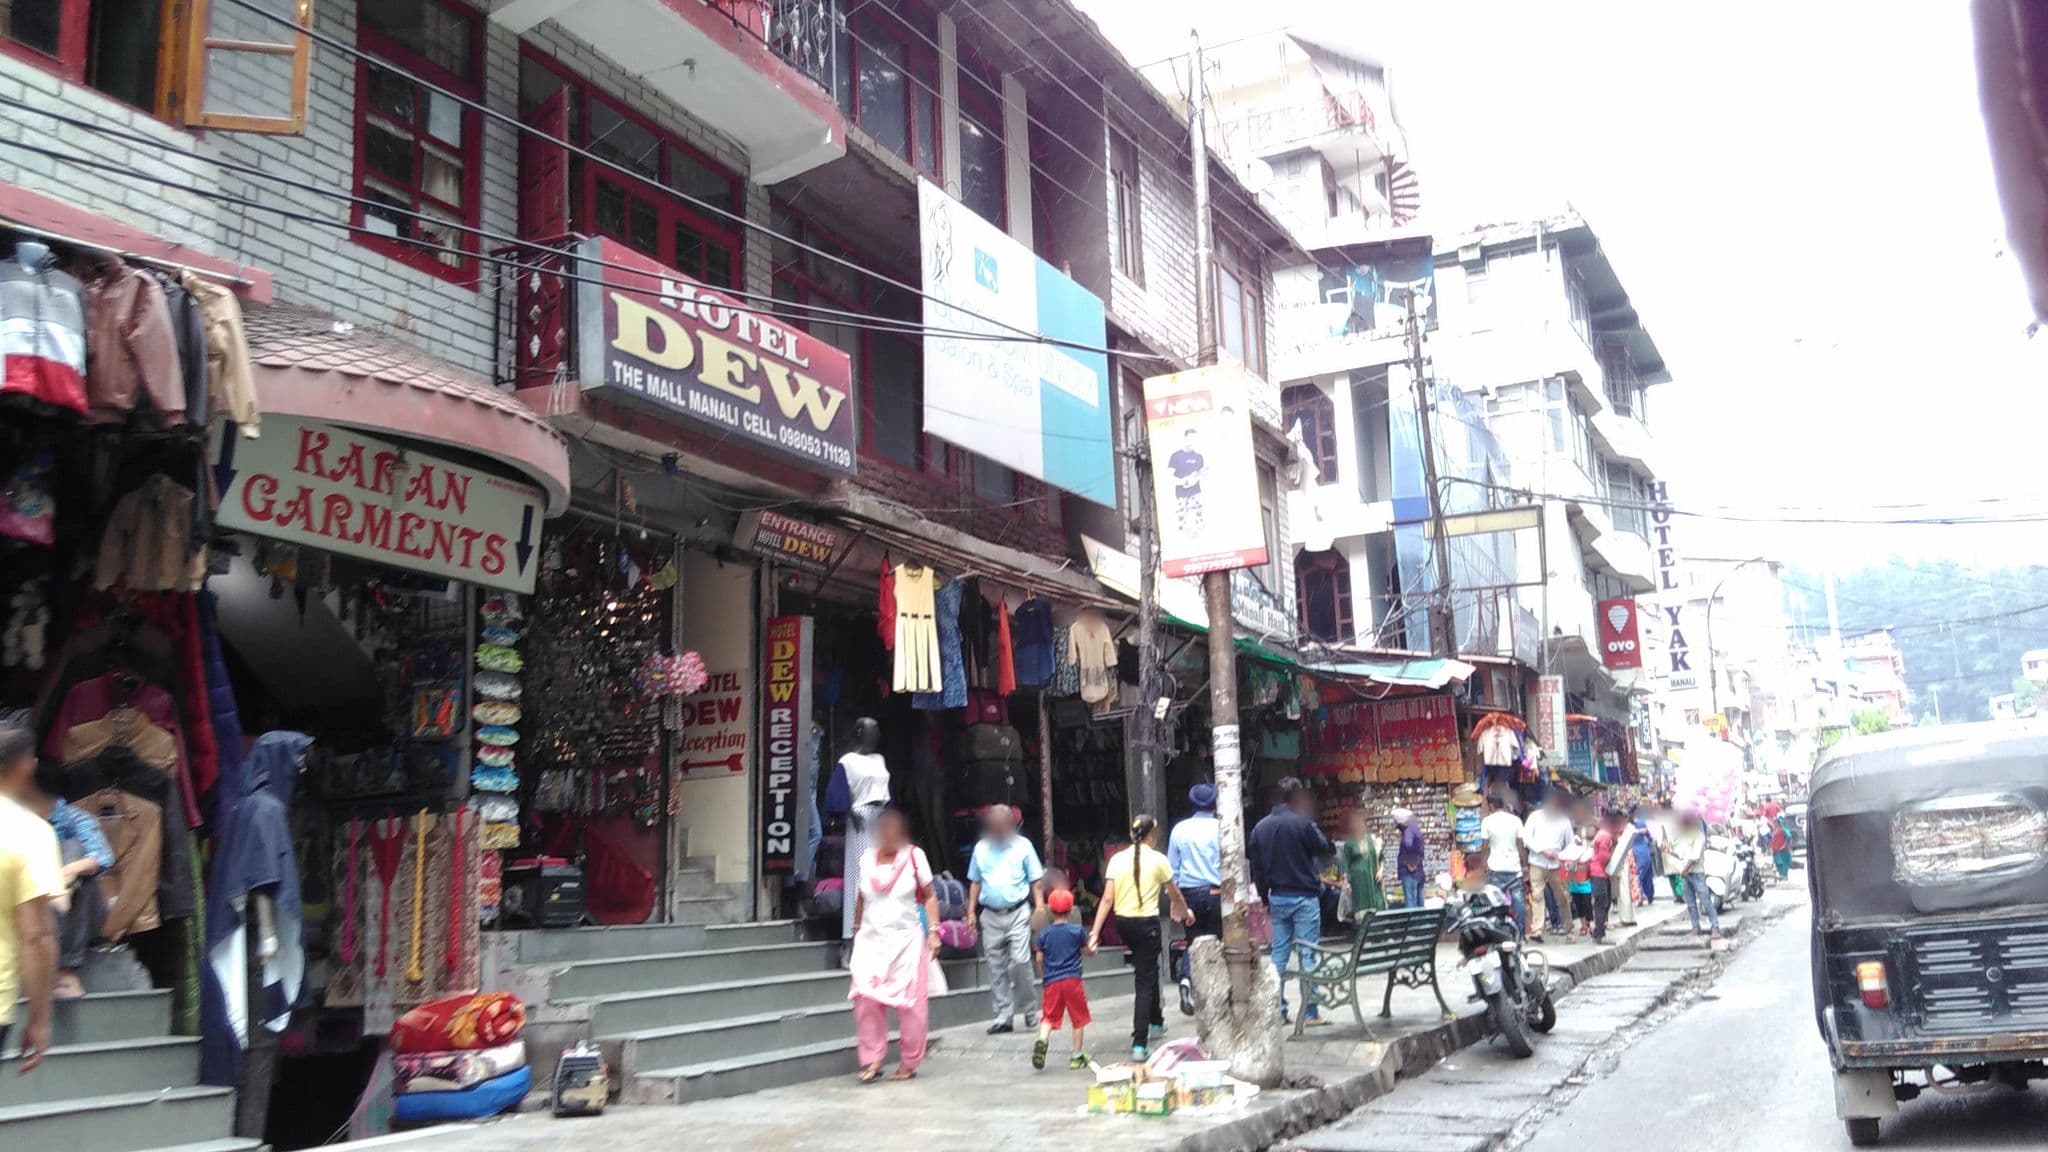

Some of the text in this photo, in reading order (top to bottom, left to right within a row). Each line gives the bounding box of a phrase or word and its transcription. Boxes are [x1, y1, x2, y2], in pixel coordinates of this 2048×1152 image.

[659, 272, 810, 368] HOTEL
[610, 291, 846, 432] DEW
[612, 360, 644, 390] THE
[647, 373, 686, 407] MALL
[689, 390, 739, 426] MANALI
[779, 427, 821, 458] 098053
[823, 440, 851, 468] 71139
[293, 426, 473, 515] KARAN
[241, 473, 508, 576] GARMENTS
[757, 530, 783, 548] HOTEL
[783, 536, 831, 562] DEW
[761, 511, 836, 546] ENTRANCE
[1650, 480, 1690, 672] HOTEL YAK
[771, 623, 796, 639] HOTEL
[1608, 640, 1635, 652] OYO
[684, 672, 741, 696] OTEL
[769, 641, 796, 703] DEW
[682, 697, 741, 728] DEW
[767, 707, 793, 855] RECEPTION
